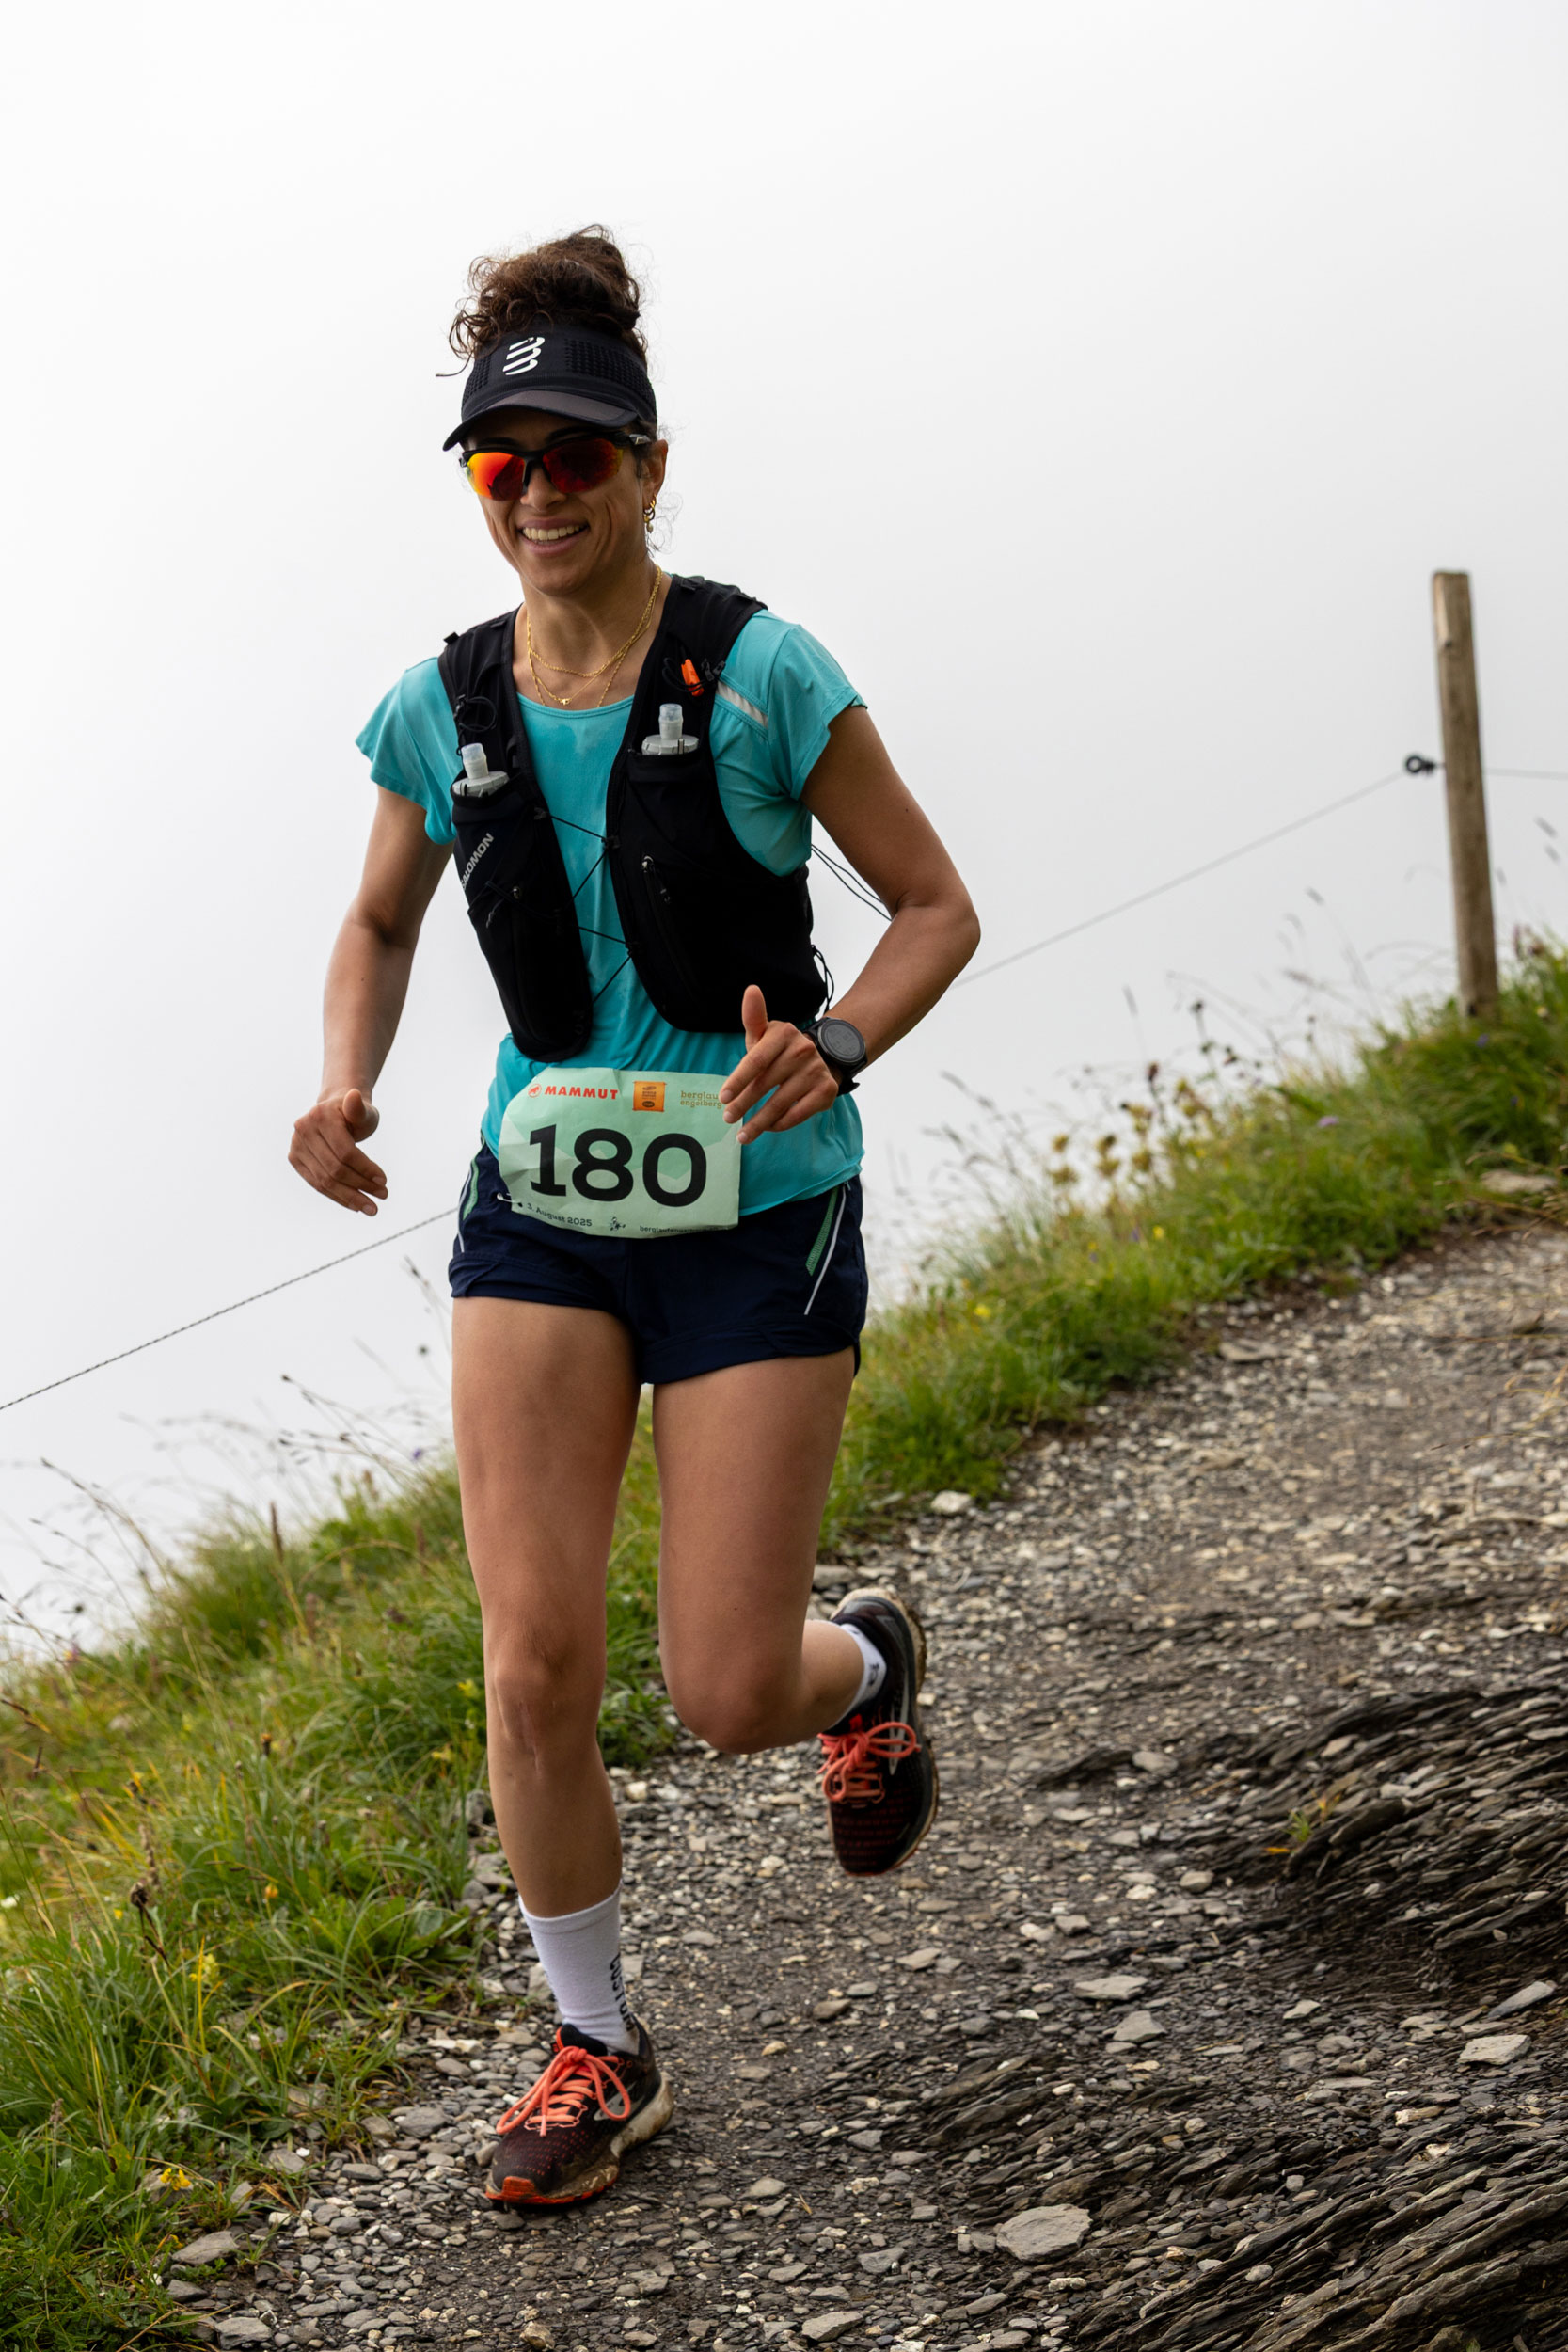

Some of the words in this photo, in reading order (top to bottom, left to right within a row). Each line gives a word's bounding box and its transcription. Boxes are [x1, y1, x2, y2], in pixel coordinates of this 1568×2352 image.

[545, 1085, 618, 1100] MAMMUT
[680, 1090, 721, 1101] berglau
[529, 1124, 706, 1208] 180
[536, 1207, 565, 1223] August
[567, 1216, 593, 1227] 2025
